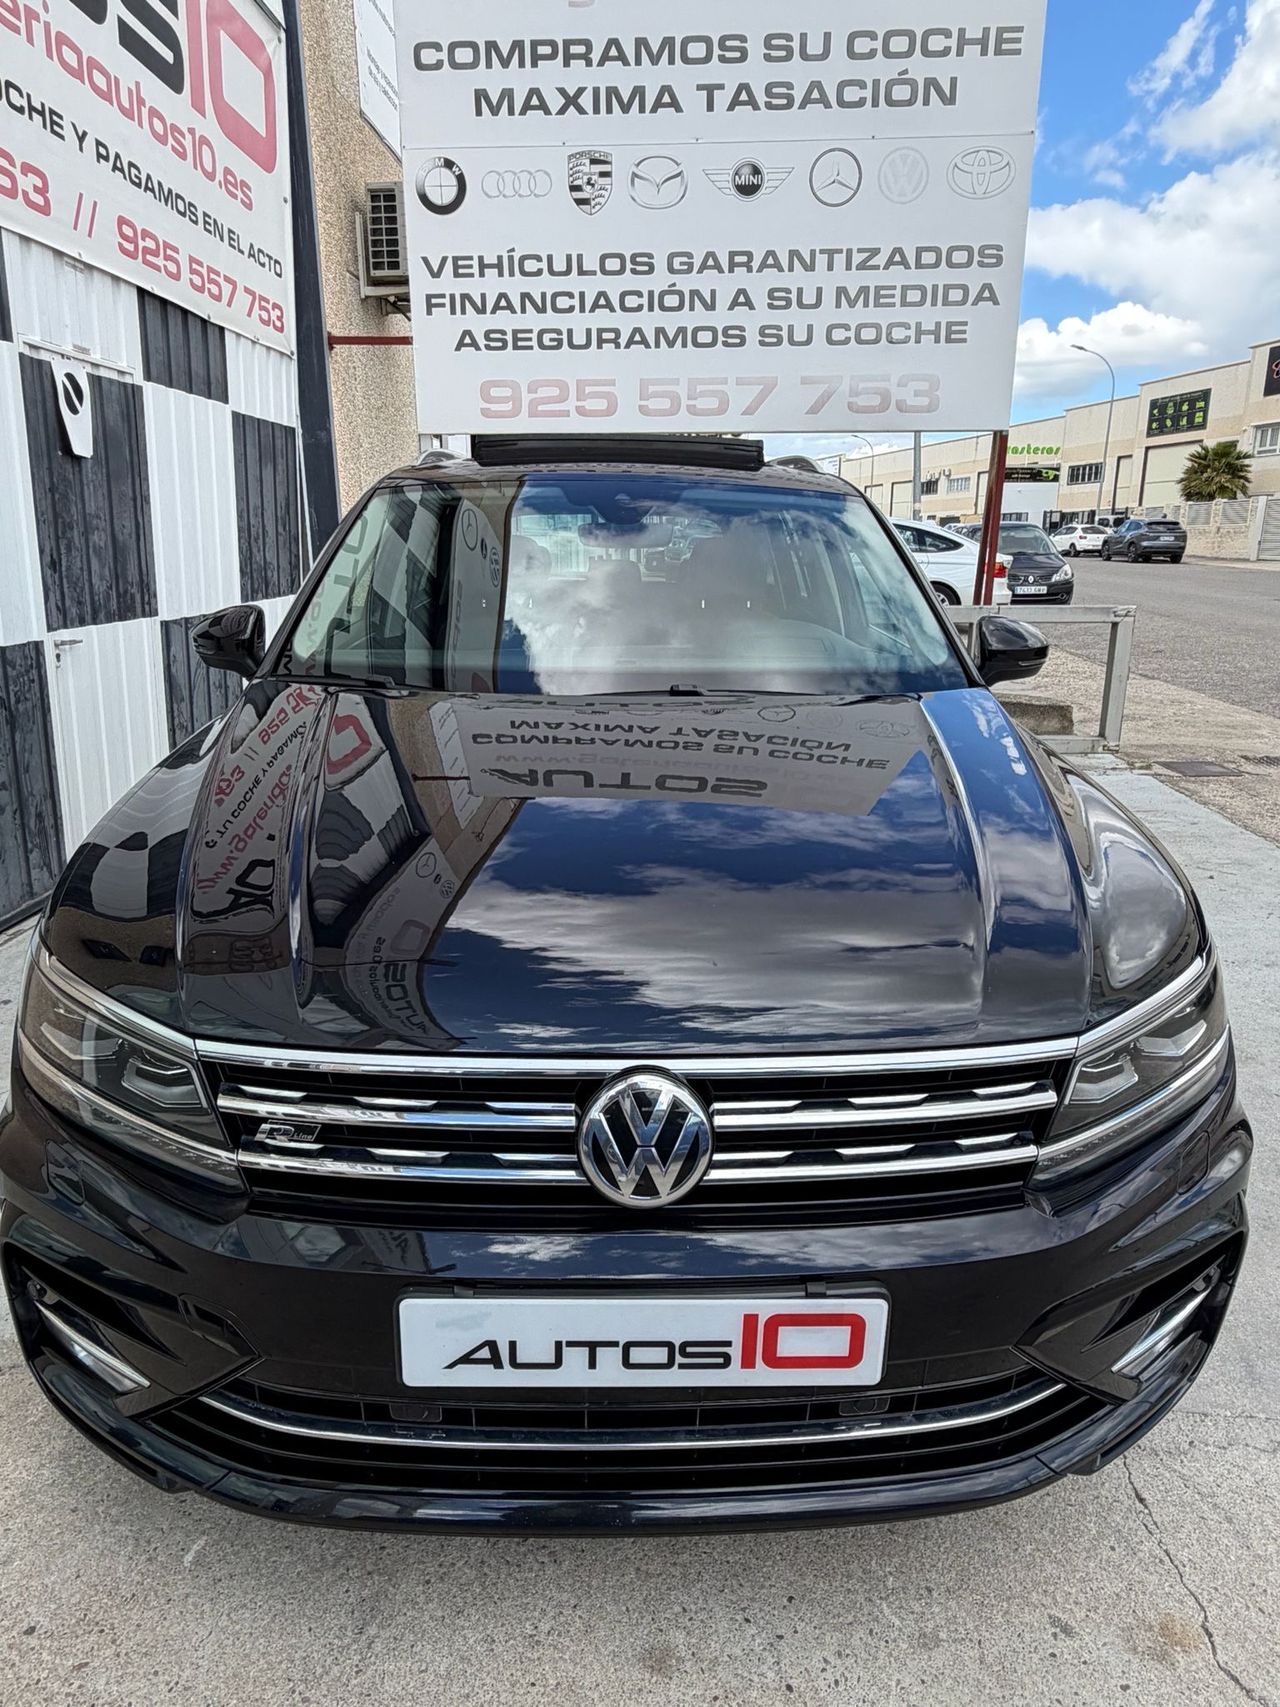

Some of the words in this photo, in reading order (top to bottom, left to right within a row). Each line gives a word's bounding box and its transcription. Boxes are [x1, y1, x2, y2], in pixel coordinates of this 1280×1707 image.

[412, 34, 749, 72] COMPRAMOS
[762, 31, 832, 63] SU
[845, 25, 1025, 61] COCHE
[473, 84, 685, 117] MAXIMA
[695, 67, 958, 113] TASACIÓN
[0, 78, 66, 142] CHE
[70, 120, 89, 154] Y
[94, 136, 199, 227] PAGAMOS
[202, 210, 225, 244] EN
[227, 227, 245, 256] EL
[247, 242, 283, 279] ACTO
[734, 173, 763, 187] MINI
[116, 214, 182, 282] 925
[188, 254, 238, 308] 557
[243, 285, 285, 335] 753
[420, 247, 656, 279] VEHÍCULOS
[666, 244, 1004, 276] GARANTIZADOS
[425, 281, 717, 316] FINANCIACIÓN
[726, 287, 756, 311] A
[766, 286, 824, 311] SU
[834, 282, 1001, 310] MEDIDA
[453, 325, 747, 352] ASEGURAMOS
[757, 323, 814, 347] SU
[825, 320, 969, 347] COCHE
[479, 377, 619, 419] 925
[637, 375, 779, 417] 557
[800, 373, 941, 415] 753
[441, 1312, 867, 1371] AUTOS10
